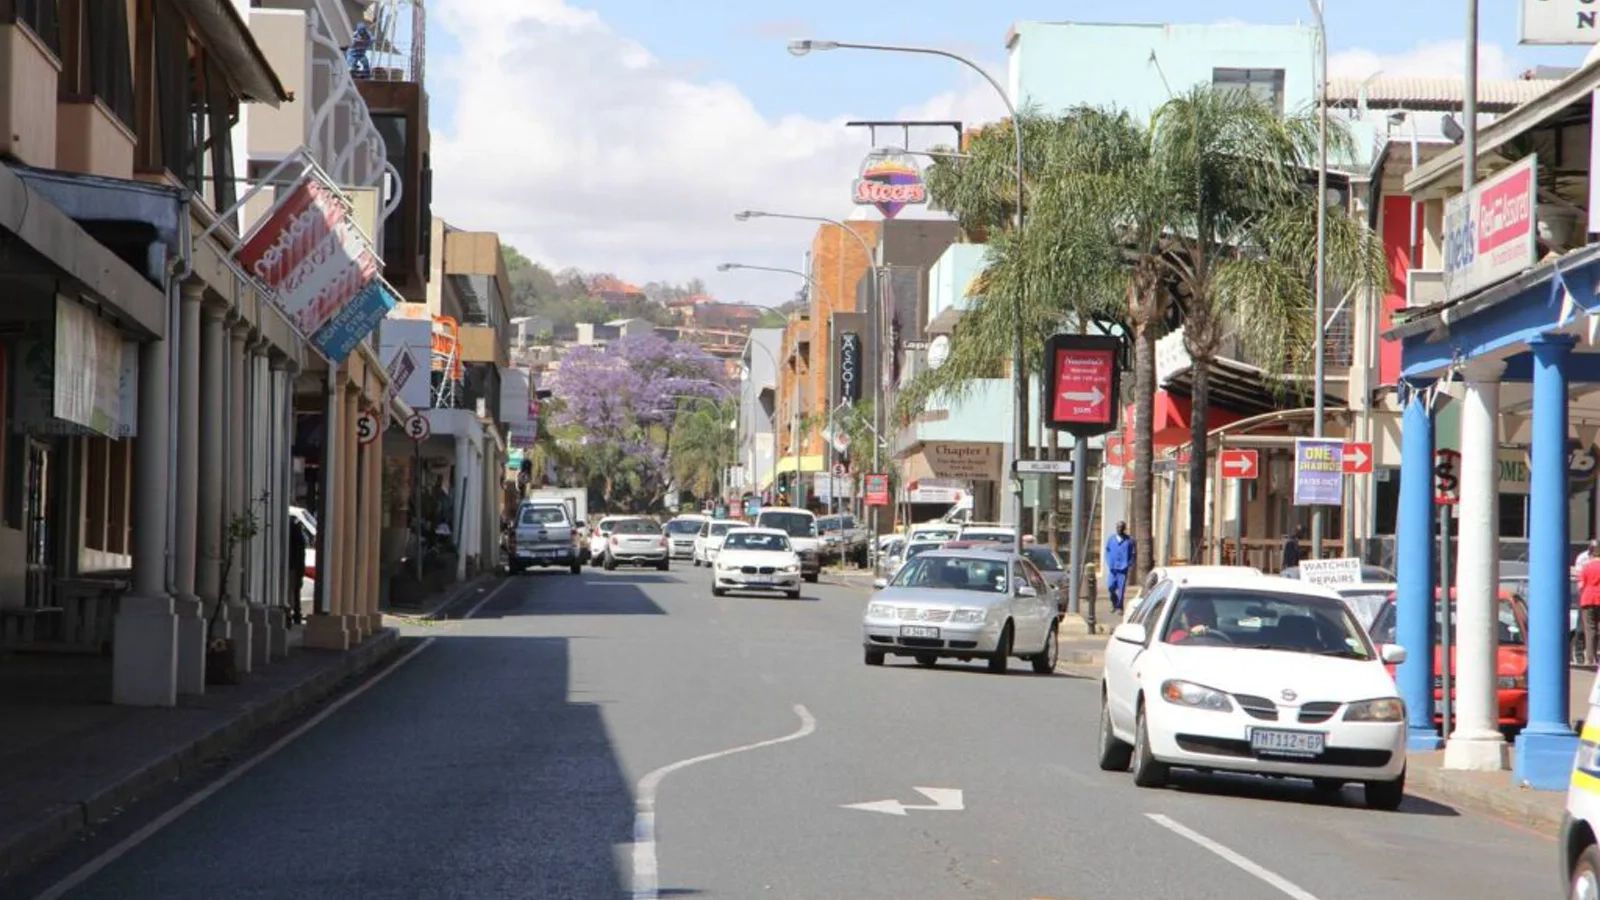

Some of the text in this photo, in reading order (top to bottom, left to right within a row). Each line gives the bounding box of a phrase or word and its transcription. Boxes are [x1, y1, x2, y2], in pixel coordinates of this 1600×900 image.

[856, 181, 924, 202] Steers
[936, 444, 981, 457] Chapter
[1304, 447, 1331, 460] ONE
[1303, 560, 1359, 571] WATCHES
[1309, 574, 1355, 585] REPAIRS
